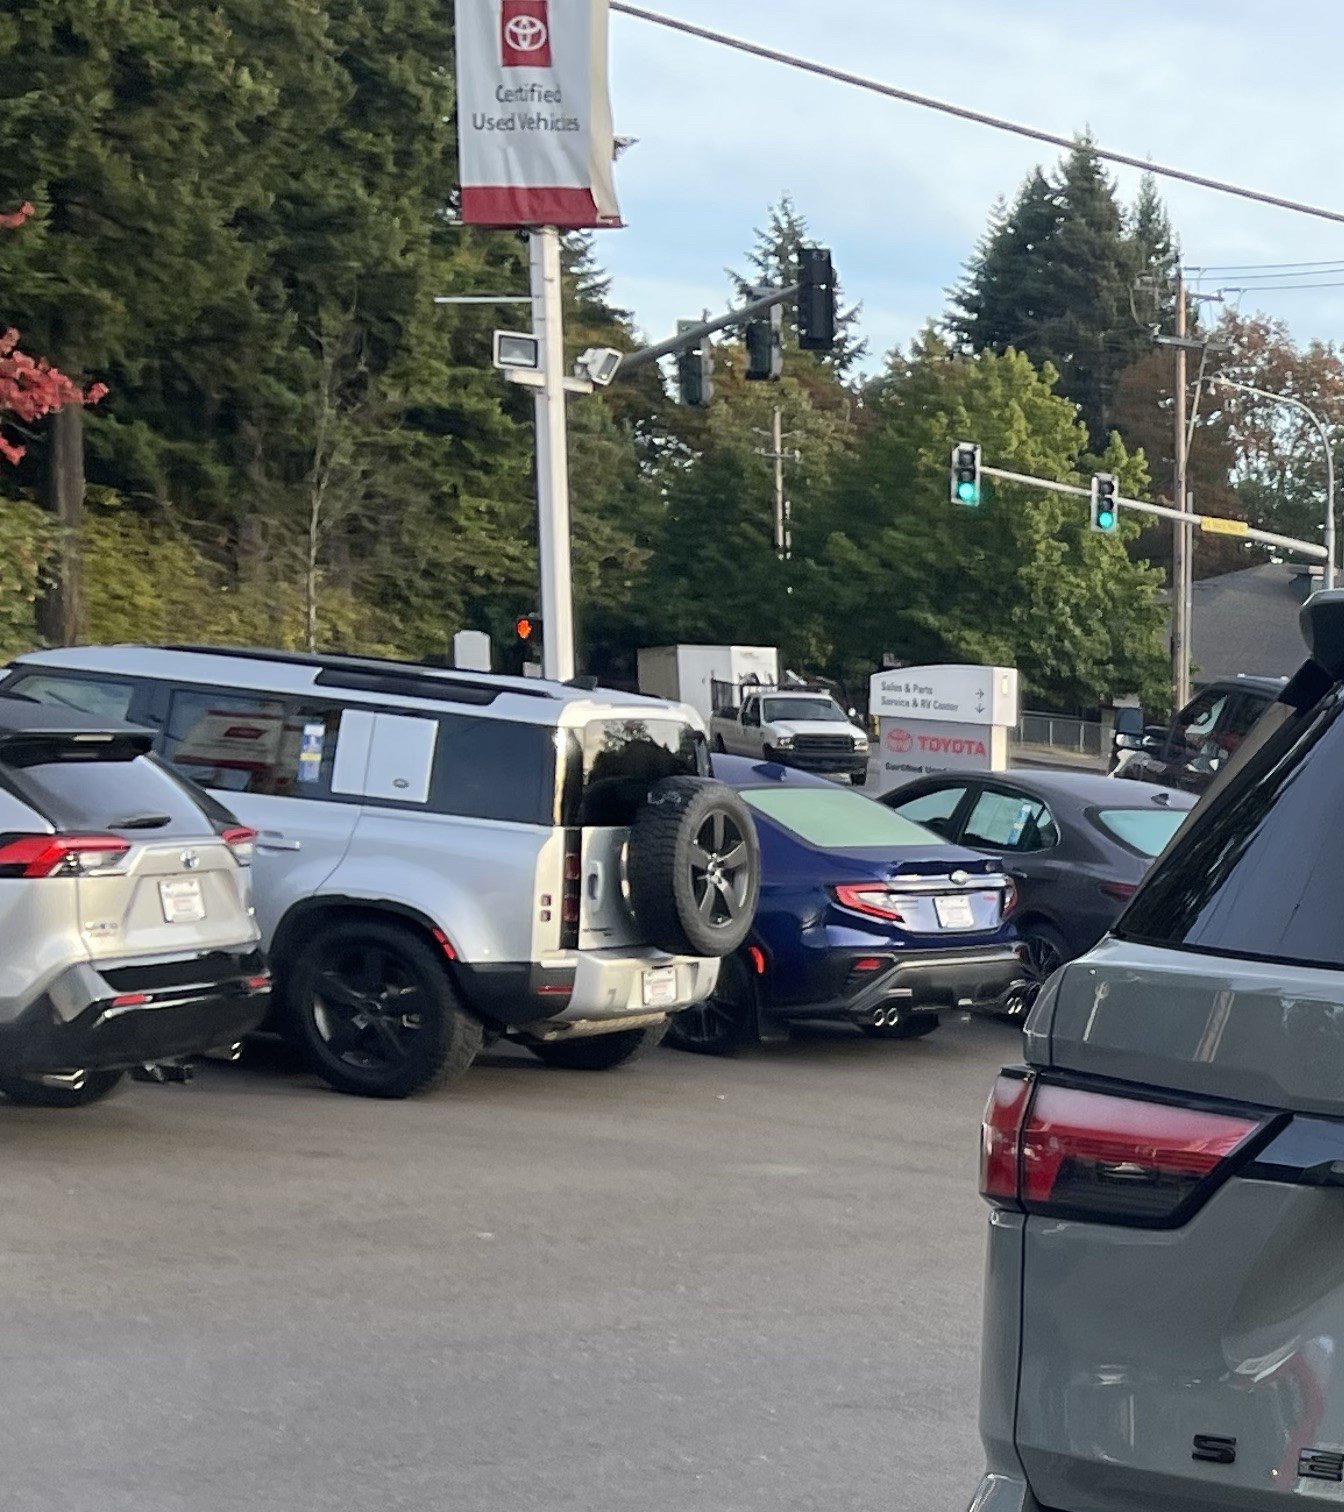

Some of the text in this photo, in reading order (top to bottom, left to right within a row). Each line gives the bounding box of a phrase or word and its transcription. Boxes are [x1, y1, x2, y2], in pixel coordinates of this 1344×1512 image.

[495, 82, 561, 104] Certified
[472, 112, 580, 131] Used Vehicles
[918, 735, 986, 756] TOYOTA
